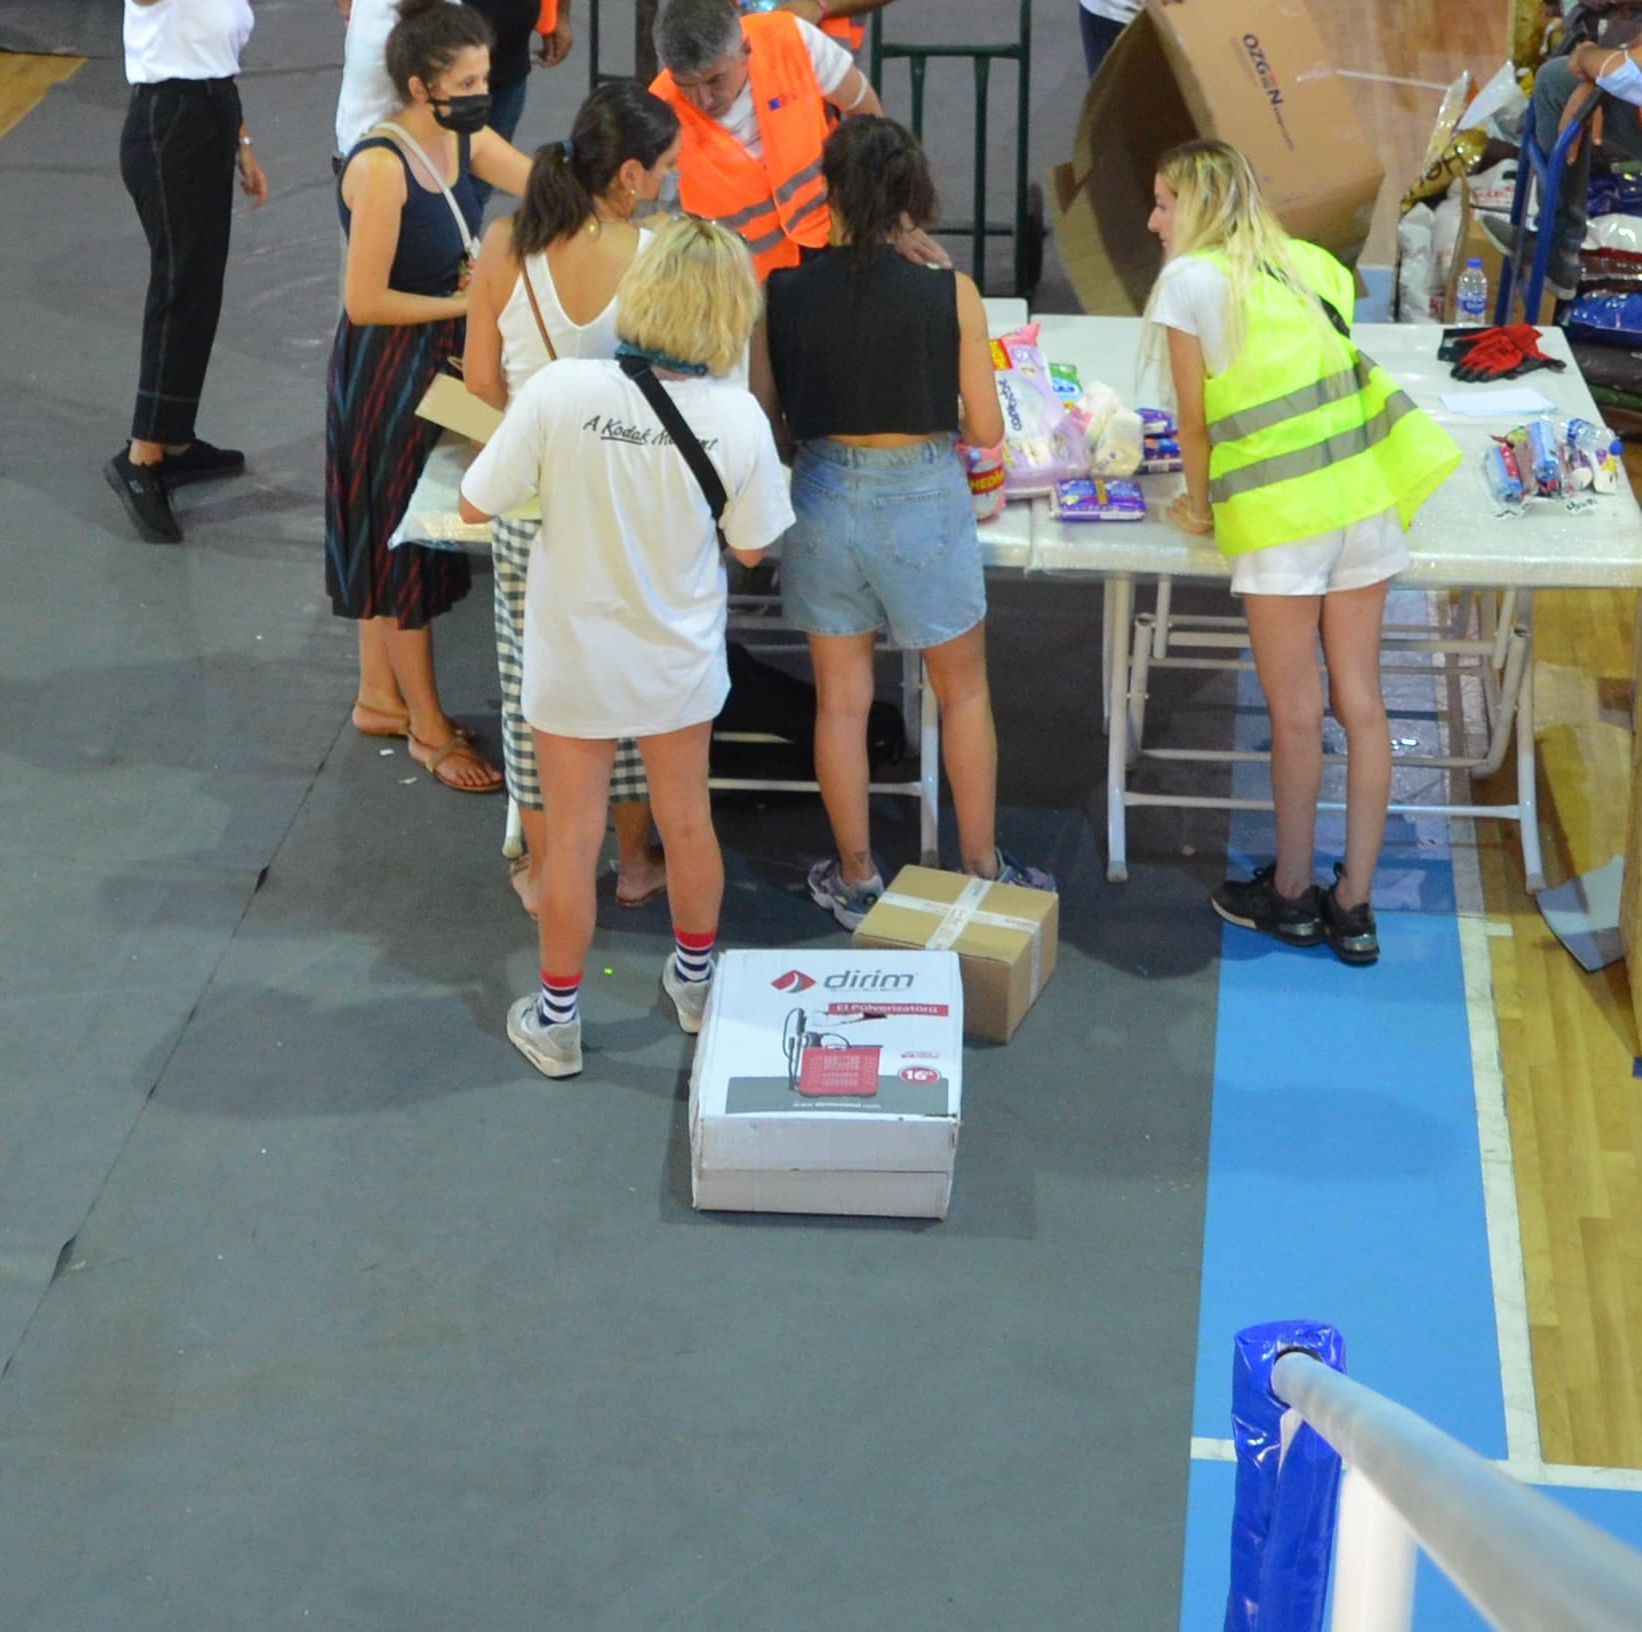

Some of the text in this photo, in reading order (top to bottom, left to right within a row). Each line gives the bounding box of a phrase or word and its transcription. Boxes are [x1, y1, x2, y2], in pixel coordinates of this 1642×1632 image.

[583, 414, 601, 431] A
[601, 418, 652, 444] Kodak
[823, 969, 916, 989] dirim
